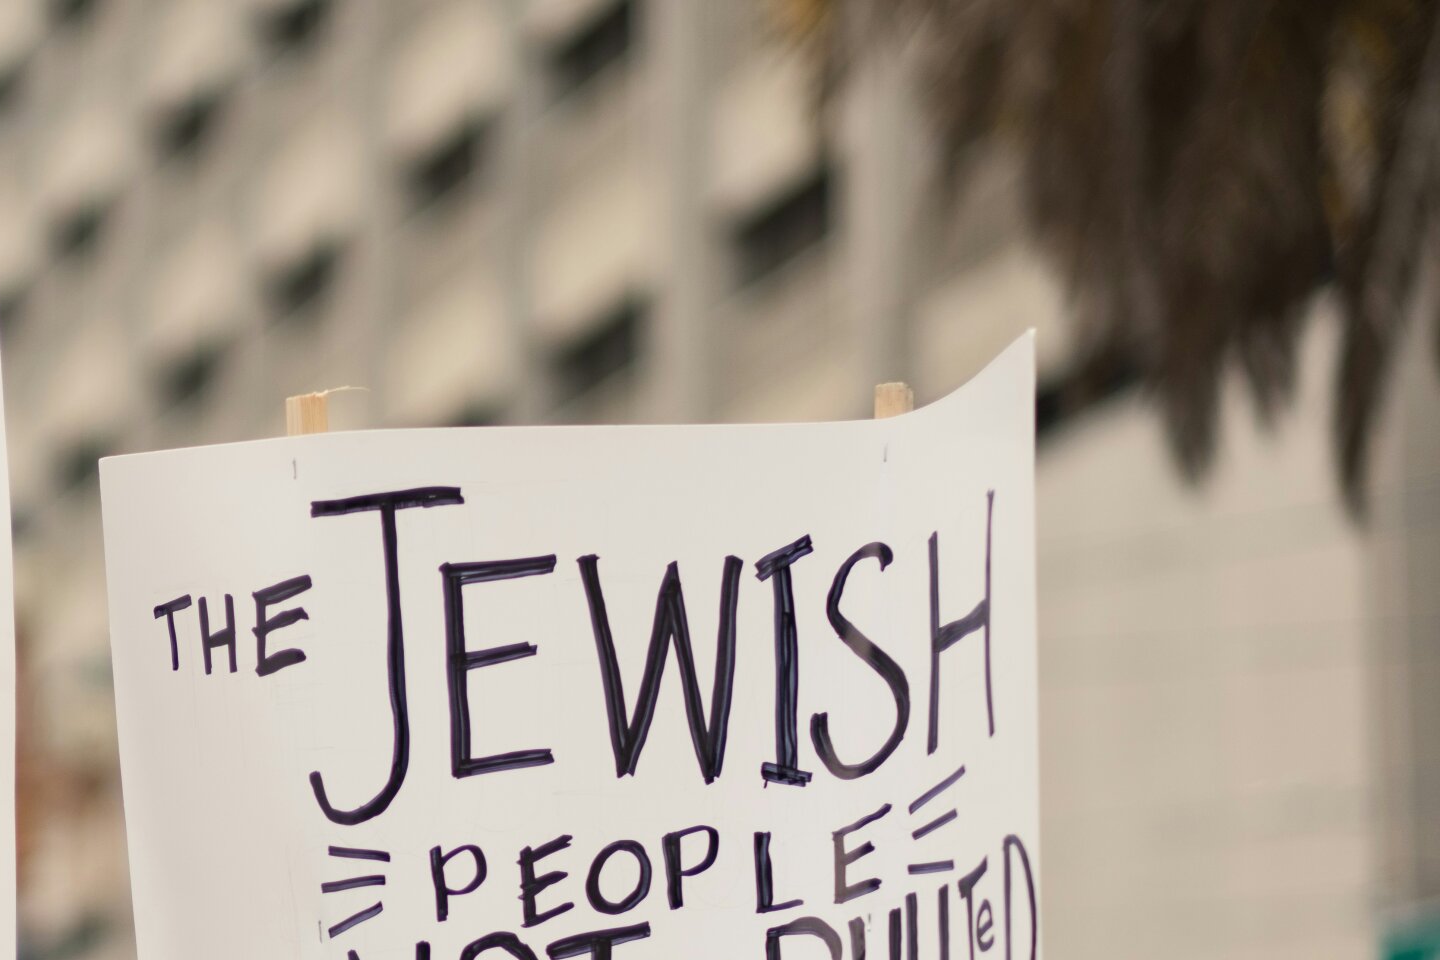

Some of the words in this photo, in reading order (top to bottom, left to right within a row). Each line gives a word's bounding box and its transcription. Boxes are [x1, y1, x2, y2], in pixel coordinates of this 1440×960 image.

[154, 575, 312, 676] THE
[309, 486, 995, 825] JEWISH
[429, 803, 892, 927] PEOPLE
